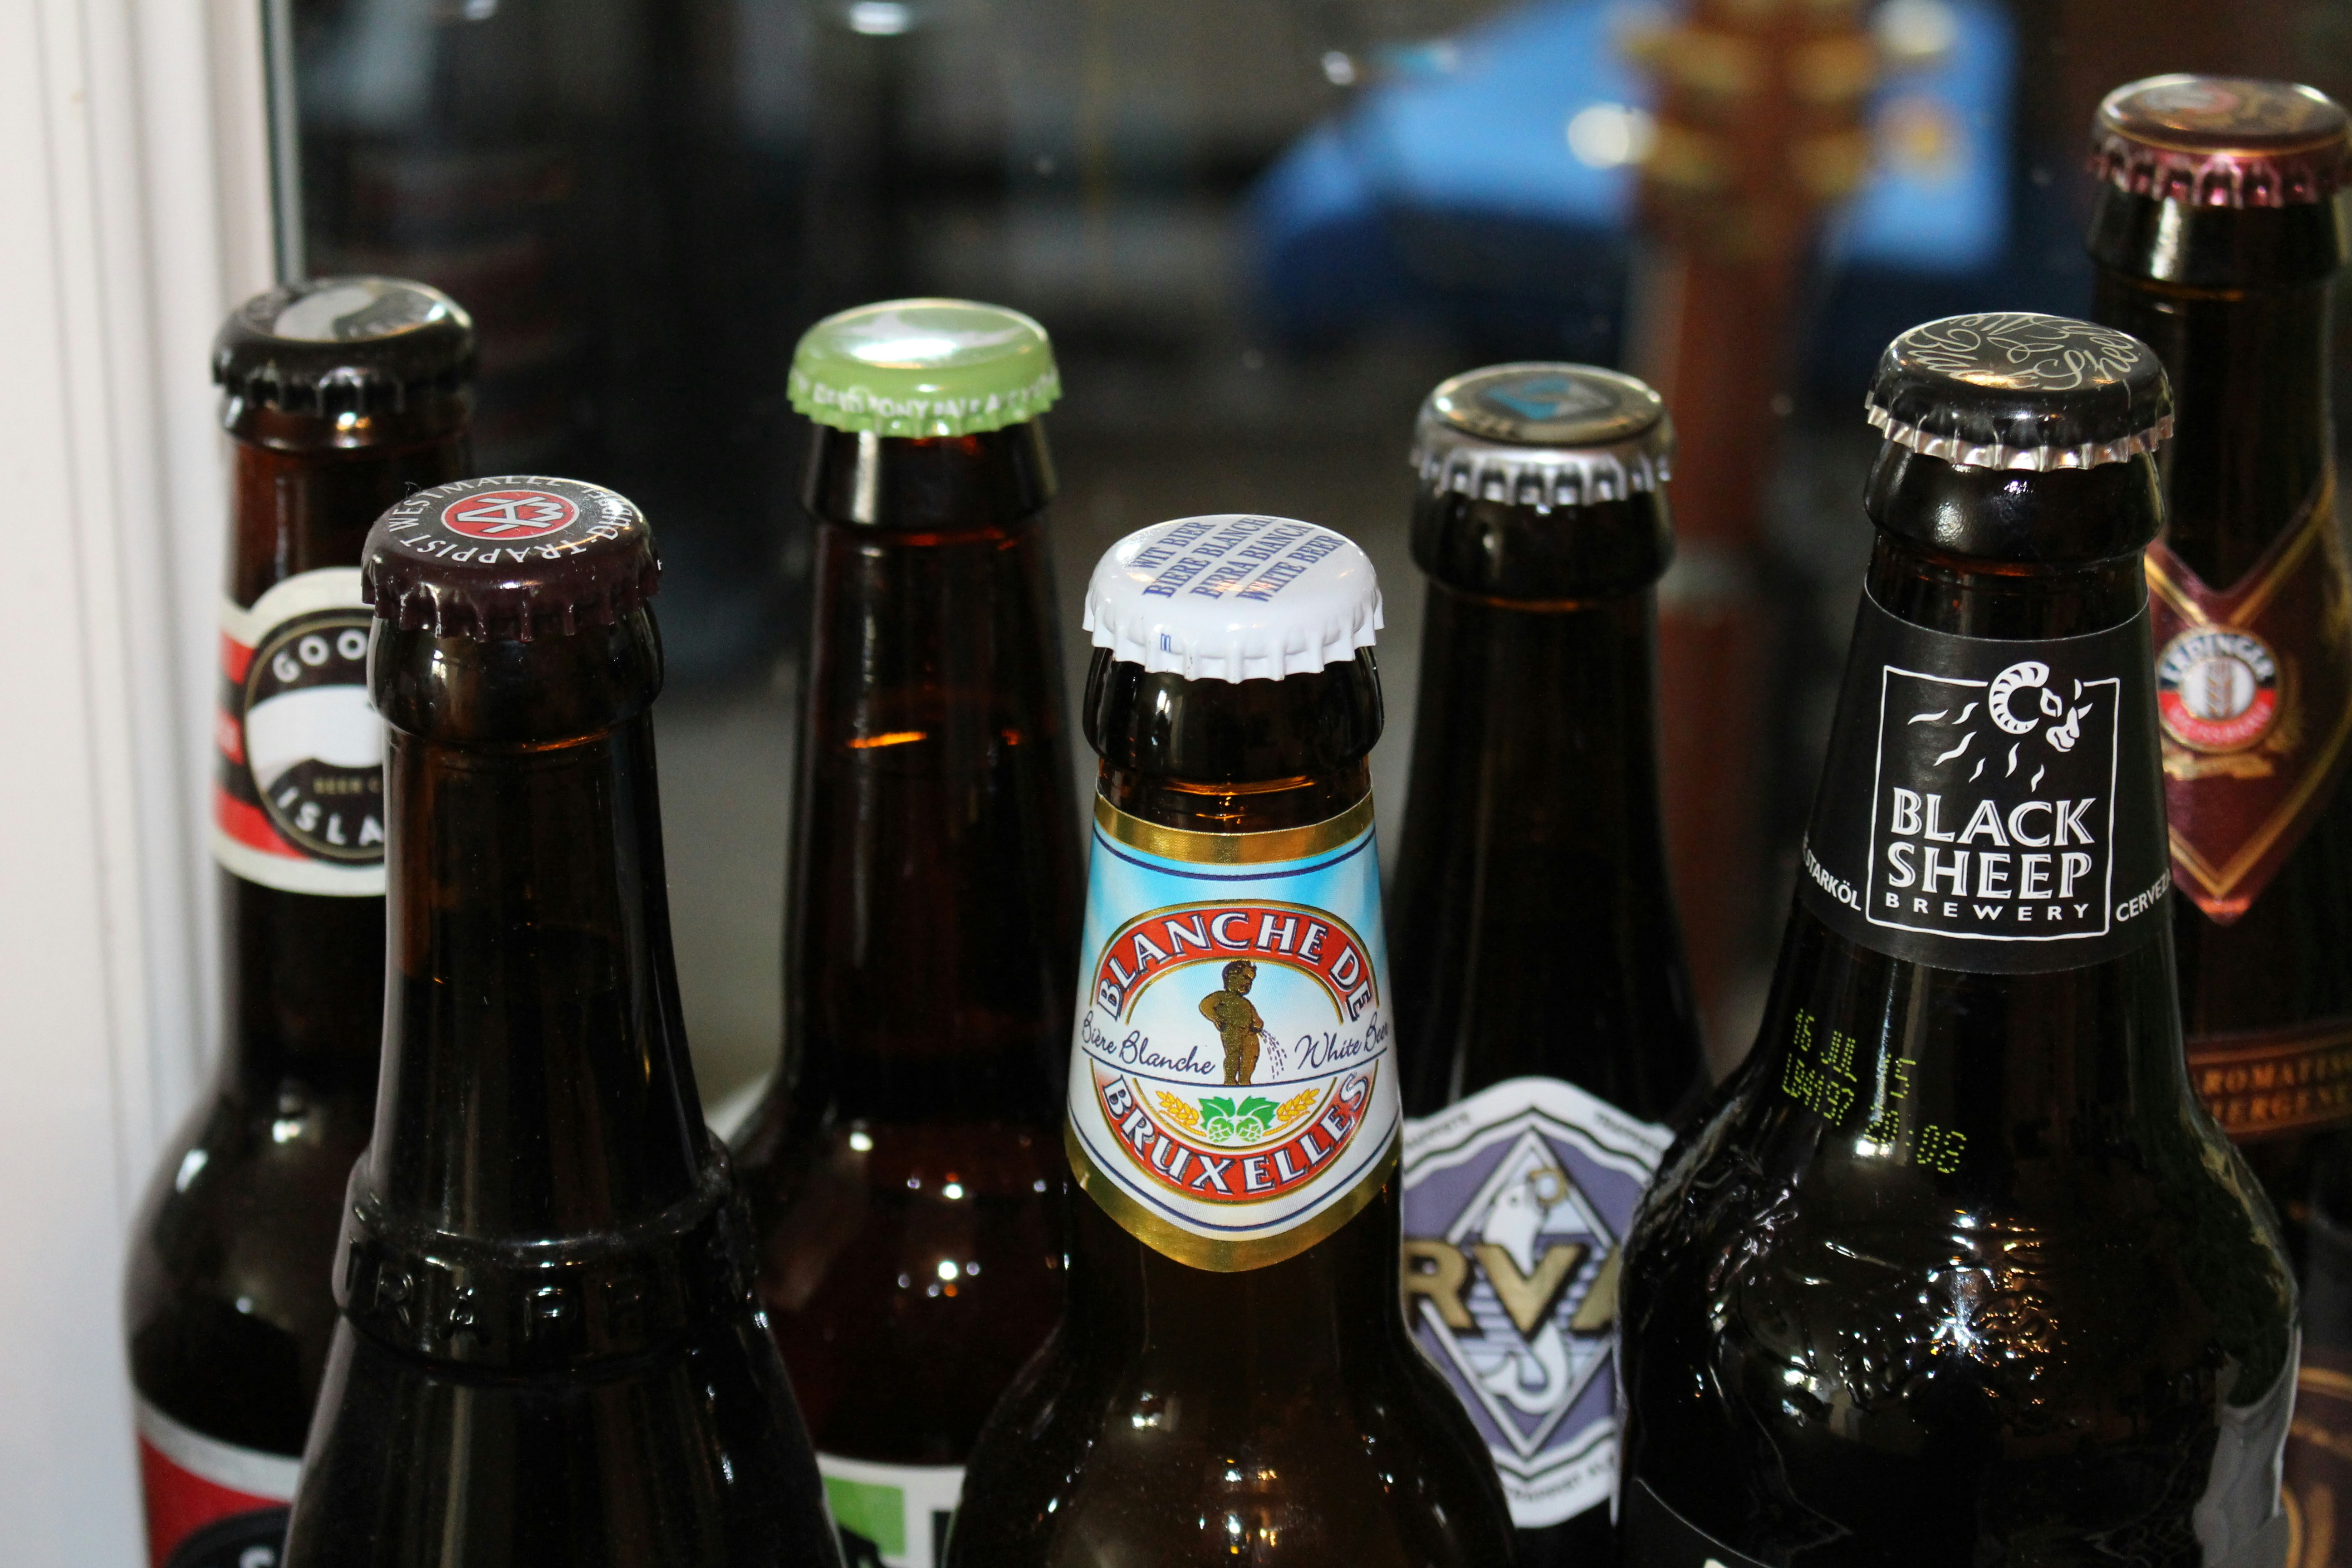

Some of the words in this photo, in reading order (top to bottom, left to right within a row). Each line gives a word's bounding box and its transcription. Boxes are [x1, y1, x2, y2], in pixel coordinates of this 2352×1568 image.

[389, 476, 561, 532] WESTMALLE
[399, 534, 587, 564] TRAPPIST
[1129, 547, 1177, 569] WIT
[1156, 522, 1217, 548] BIER
[1188, 560, 1259, 599] BIRRA
[1238, 523, 1316, 561] BIANCA
[1235, 561, 1308, 602] WHITE
[1285, 535, 1347, 564] BEER
[1141, 557, 1212, 598] BIERE
[272, 629, 368, 682] GOO
[276, 786, 384, 846] ISLA
[1891, 787, 2096, 847] BLACK
[1887, 842, 2092, 899] SHEEP
[1885, 892, 2089, 921] BREWERY
[1097, 911, 1328, 1021] BLANCHE
[1328, 944, 1373, 1023] DE
[1082, 1010, 1117, 1054] Bière
[1119, 1030, 1215, 1075] Blanche
[1294, 1031, 1362, 1070] White
[1102, 1071, 1369, 1195] BRUXELLES
